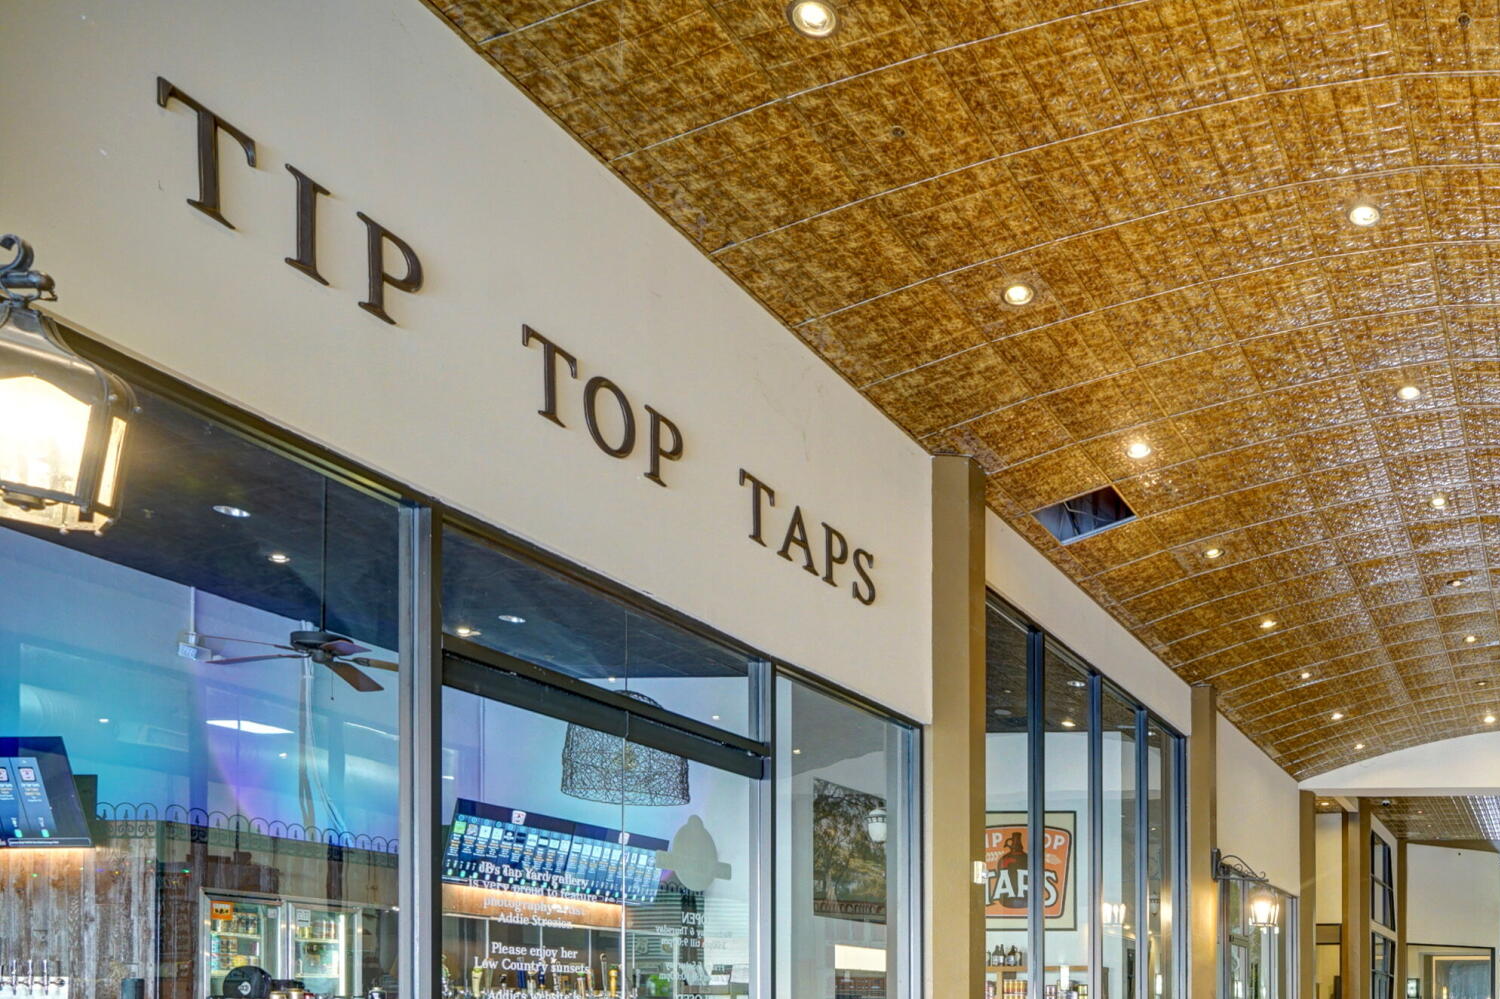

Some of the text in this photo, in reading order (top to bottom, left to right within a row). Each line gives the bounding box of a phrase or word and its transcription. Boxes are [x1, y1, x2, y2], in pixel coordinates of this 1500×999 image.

[156, 76, 876, 606] TIP TOP TAPS
[985, 832, 1003, 849] IP
[502, 864, 522, 879] Tap
[525, 868, 550, 882] Yard
[551, 872, 588, 890] gallery
[483, 881, 509, 893] very
[511, 882, 544, 898] proud
[548, 887, 558, 898] to
[560, 888, 597, 903] feature
[484, 896, 552, 914] photography
[497, 912, 530, 924] Addie
[491, 941, 578, 961] Please enjoy her
[474, 956, 590, 974] Low Country sunsets
